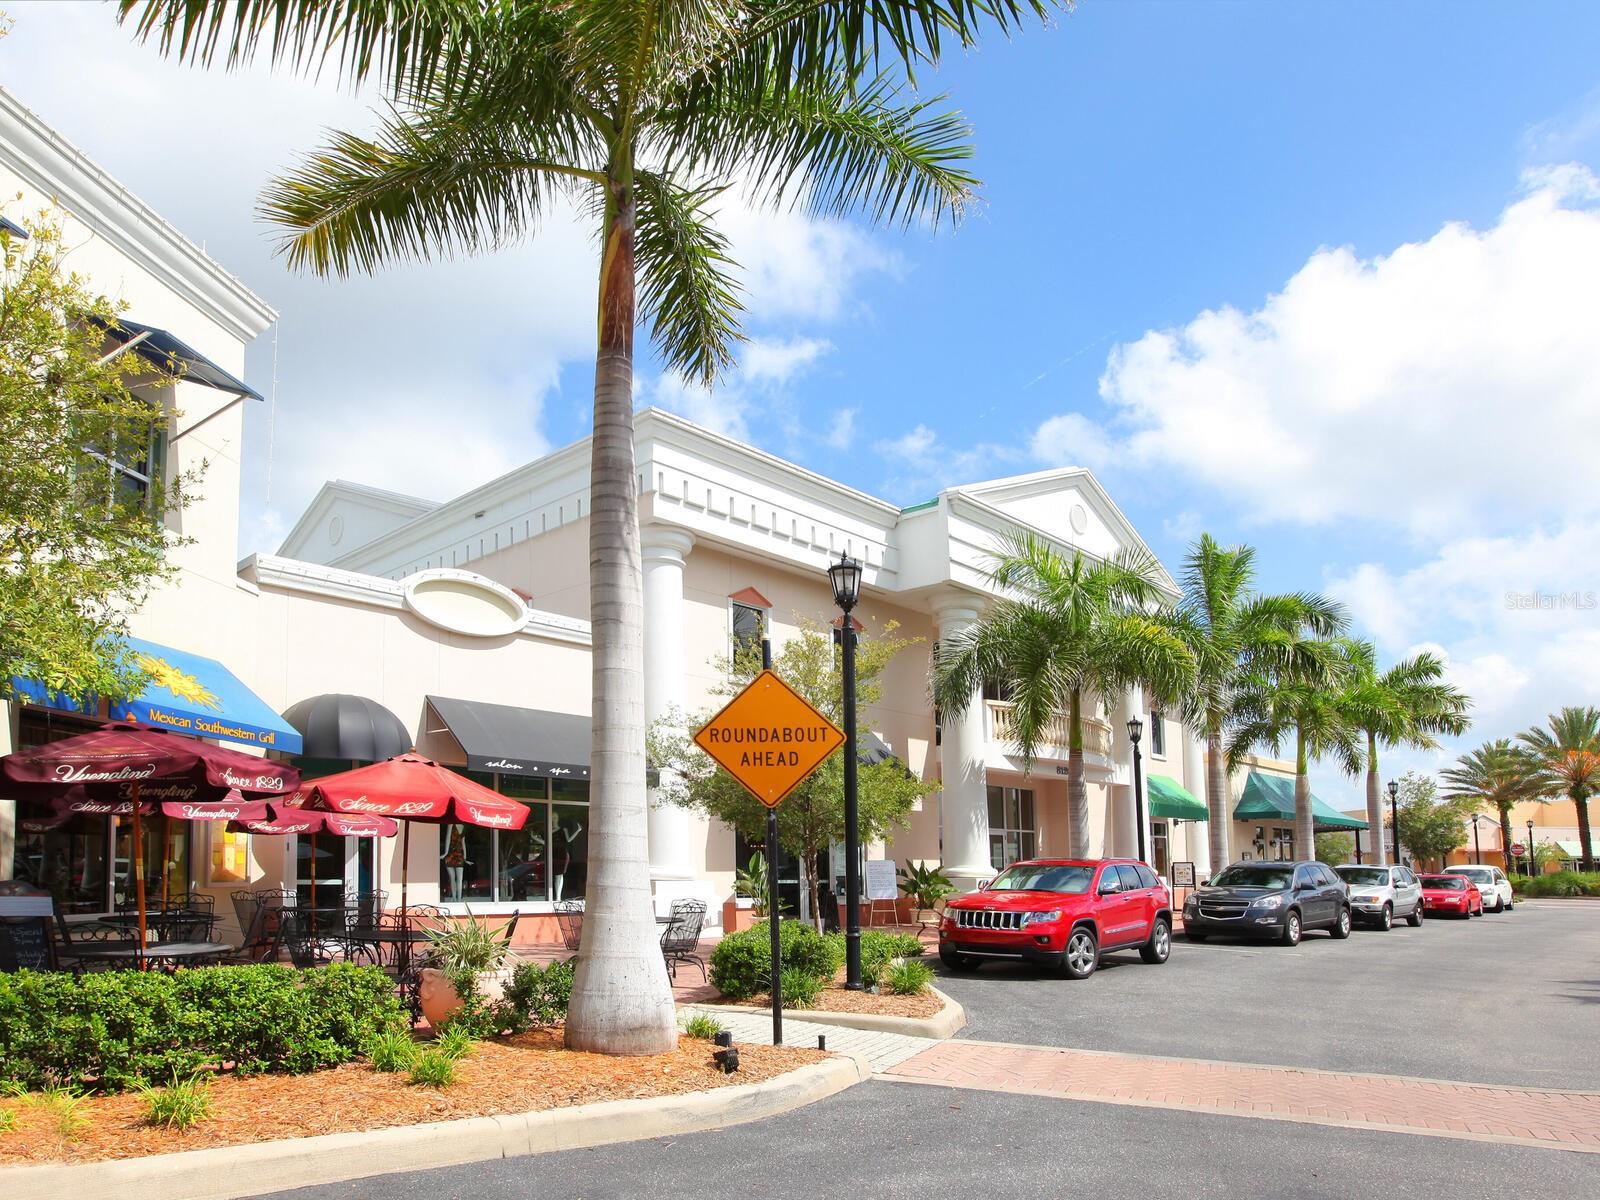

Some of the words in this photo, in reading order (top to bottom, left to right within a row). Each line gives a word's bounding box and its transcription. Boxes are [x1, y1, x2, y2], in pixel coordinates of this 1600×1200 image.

[149, 708, 191, 728] Mexican
[194, 718, 256, 741] Southwestern
[258, 731, 276, 745] Grill
[709, 727, 828, 743] ROUNDABOUT
[484, 759, 524, 770] salon
[549, 767, 571, 776] spa
[740, 751, 799, 767] AHEAD
[219, 767, 253, 787] Since
[255, 775, 284, 790] 1829
[69, 799, 112, 813] Since
[182, 804, 240, 819] Yuengling
[339, 795, 391, 812] Since
[392, 801, 434, 814] 1829
[469, 806, 513, 828] Yuengling
